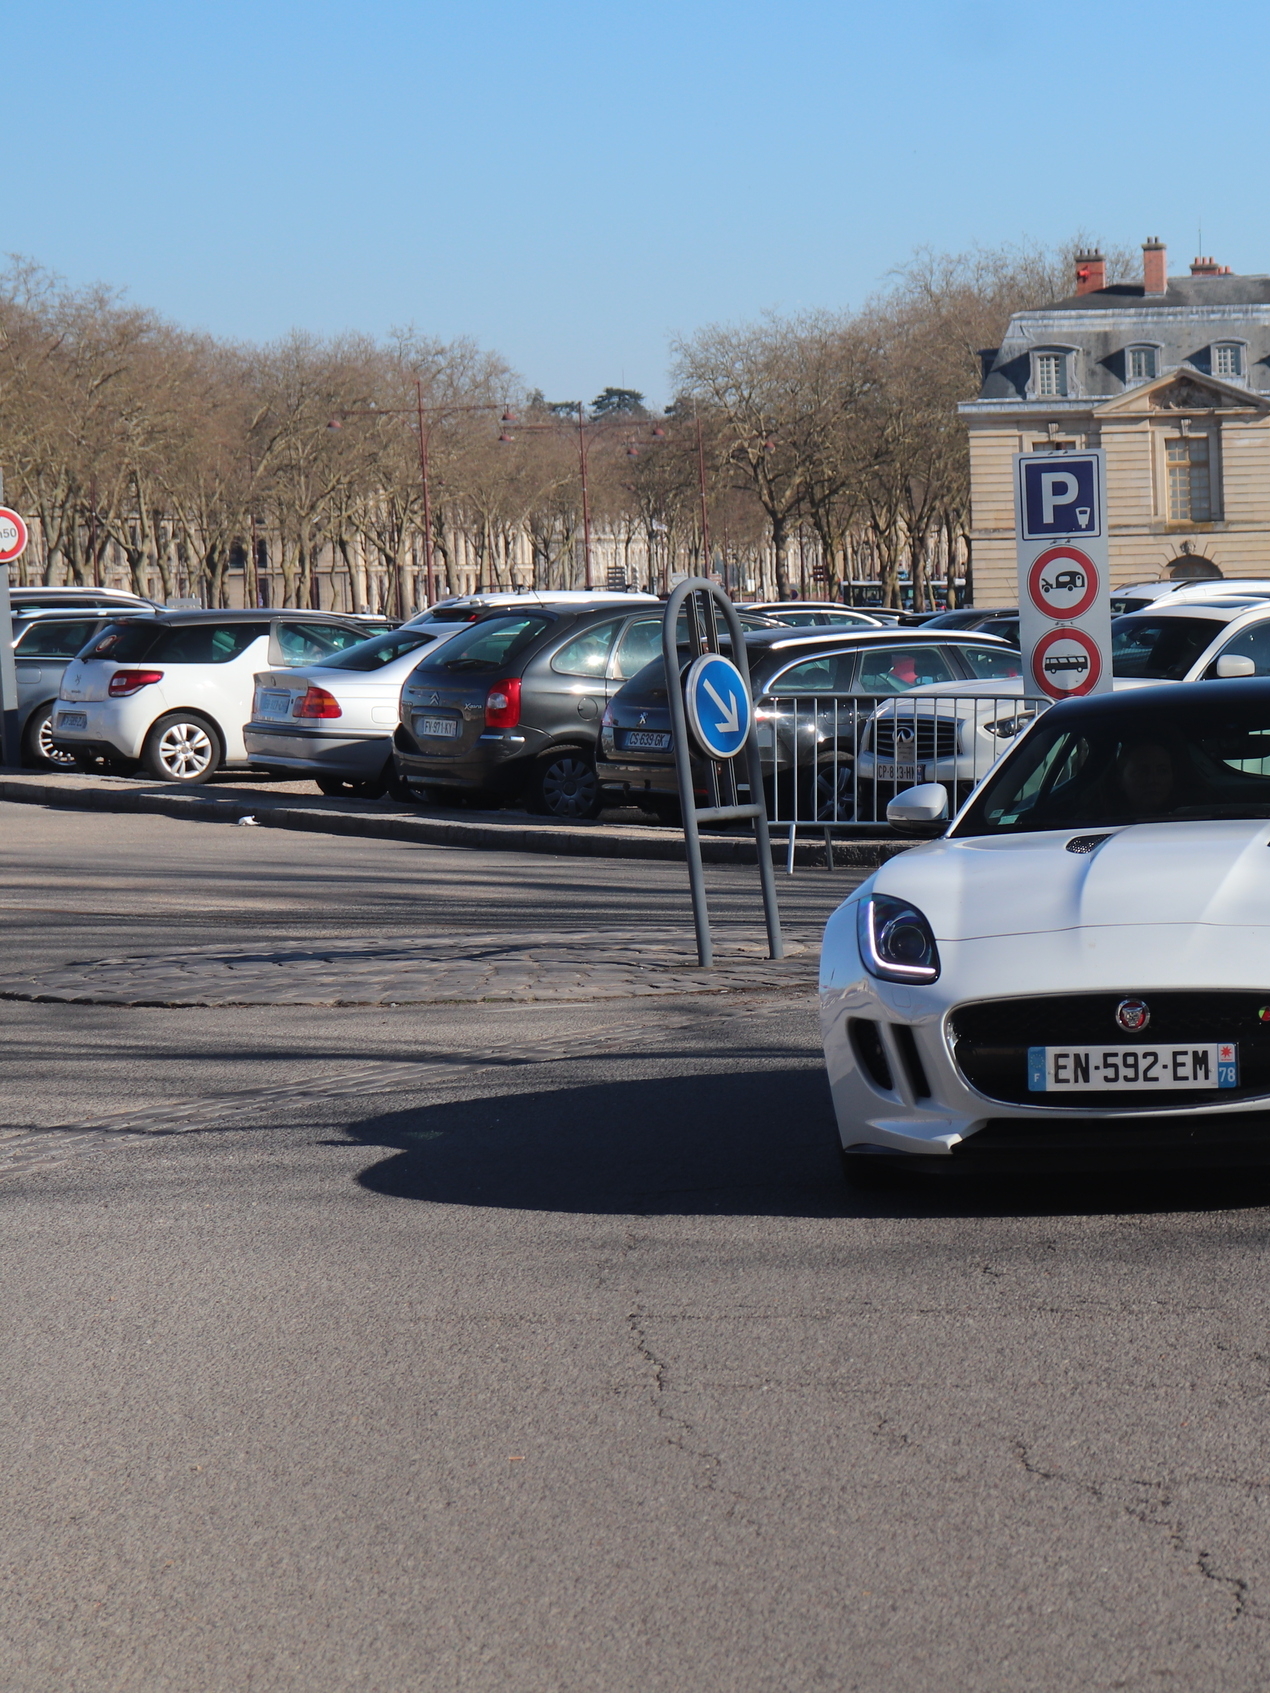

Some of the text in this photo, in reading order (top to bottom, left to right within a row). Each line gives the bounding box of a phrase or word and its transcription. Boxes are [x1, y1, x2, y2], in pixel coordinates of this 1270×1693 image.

[1041, 471, 1079, 524] P
[1034, 1050, 1236, 1084] F EN-592-EM 78
